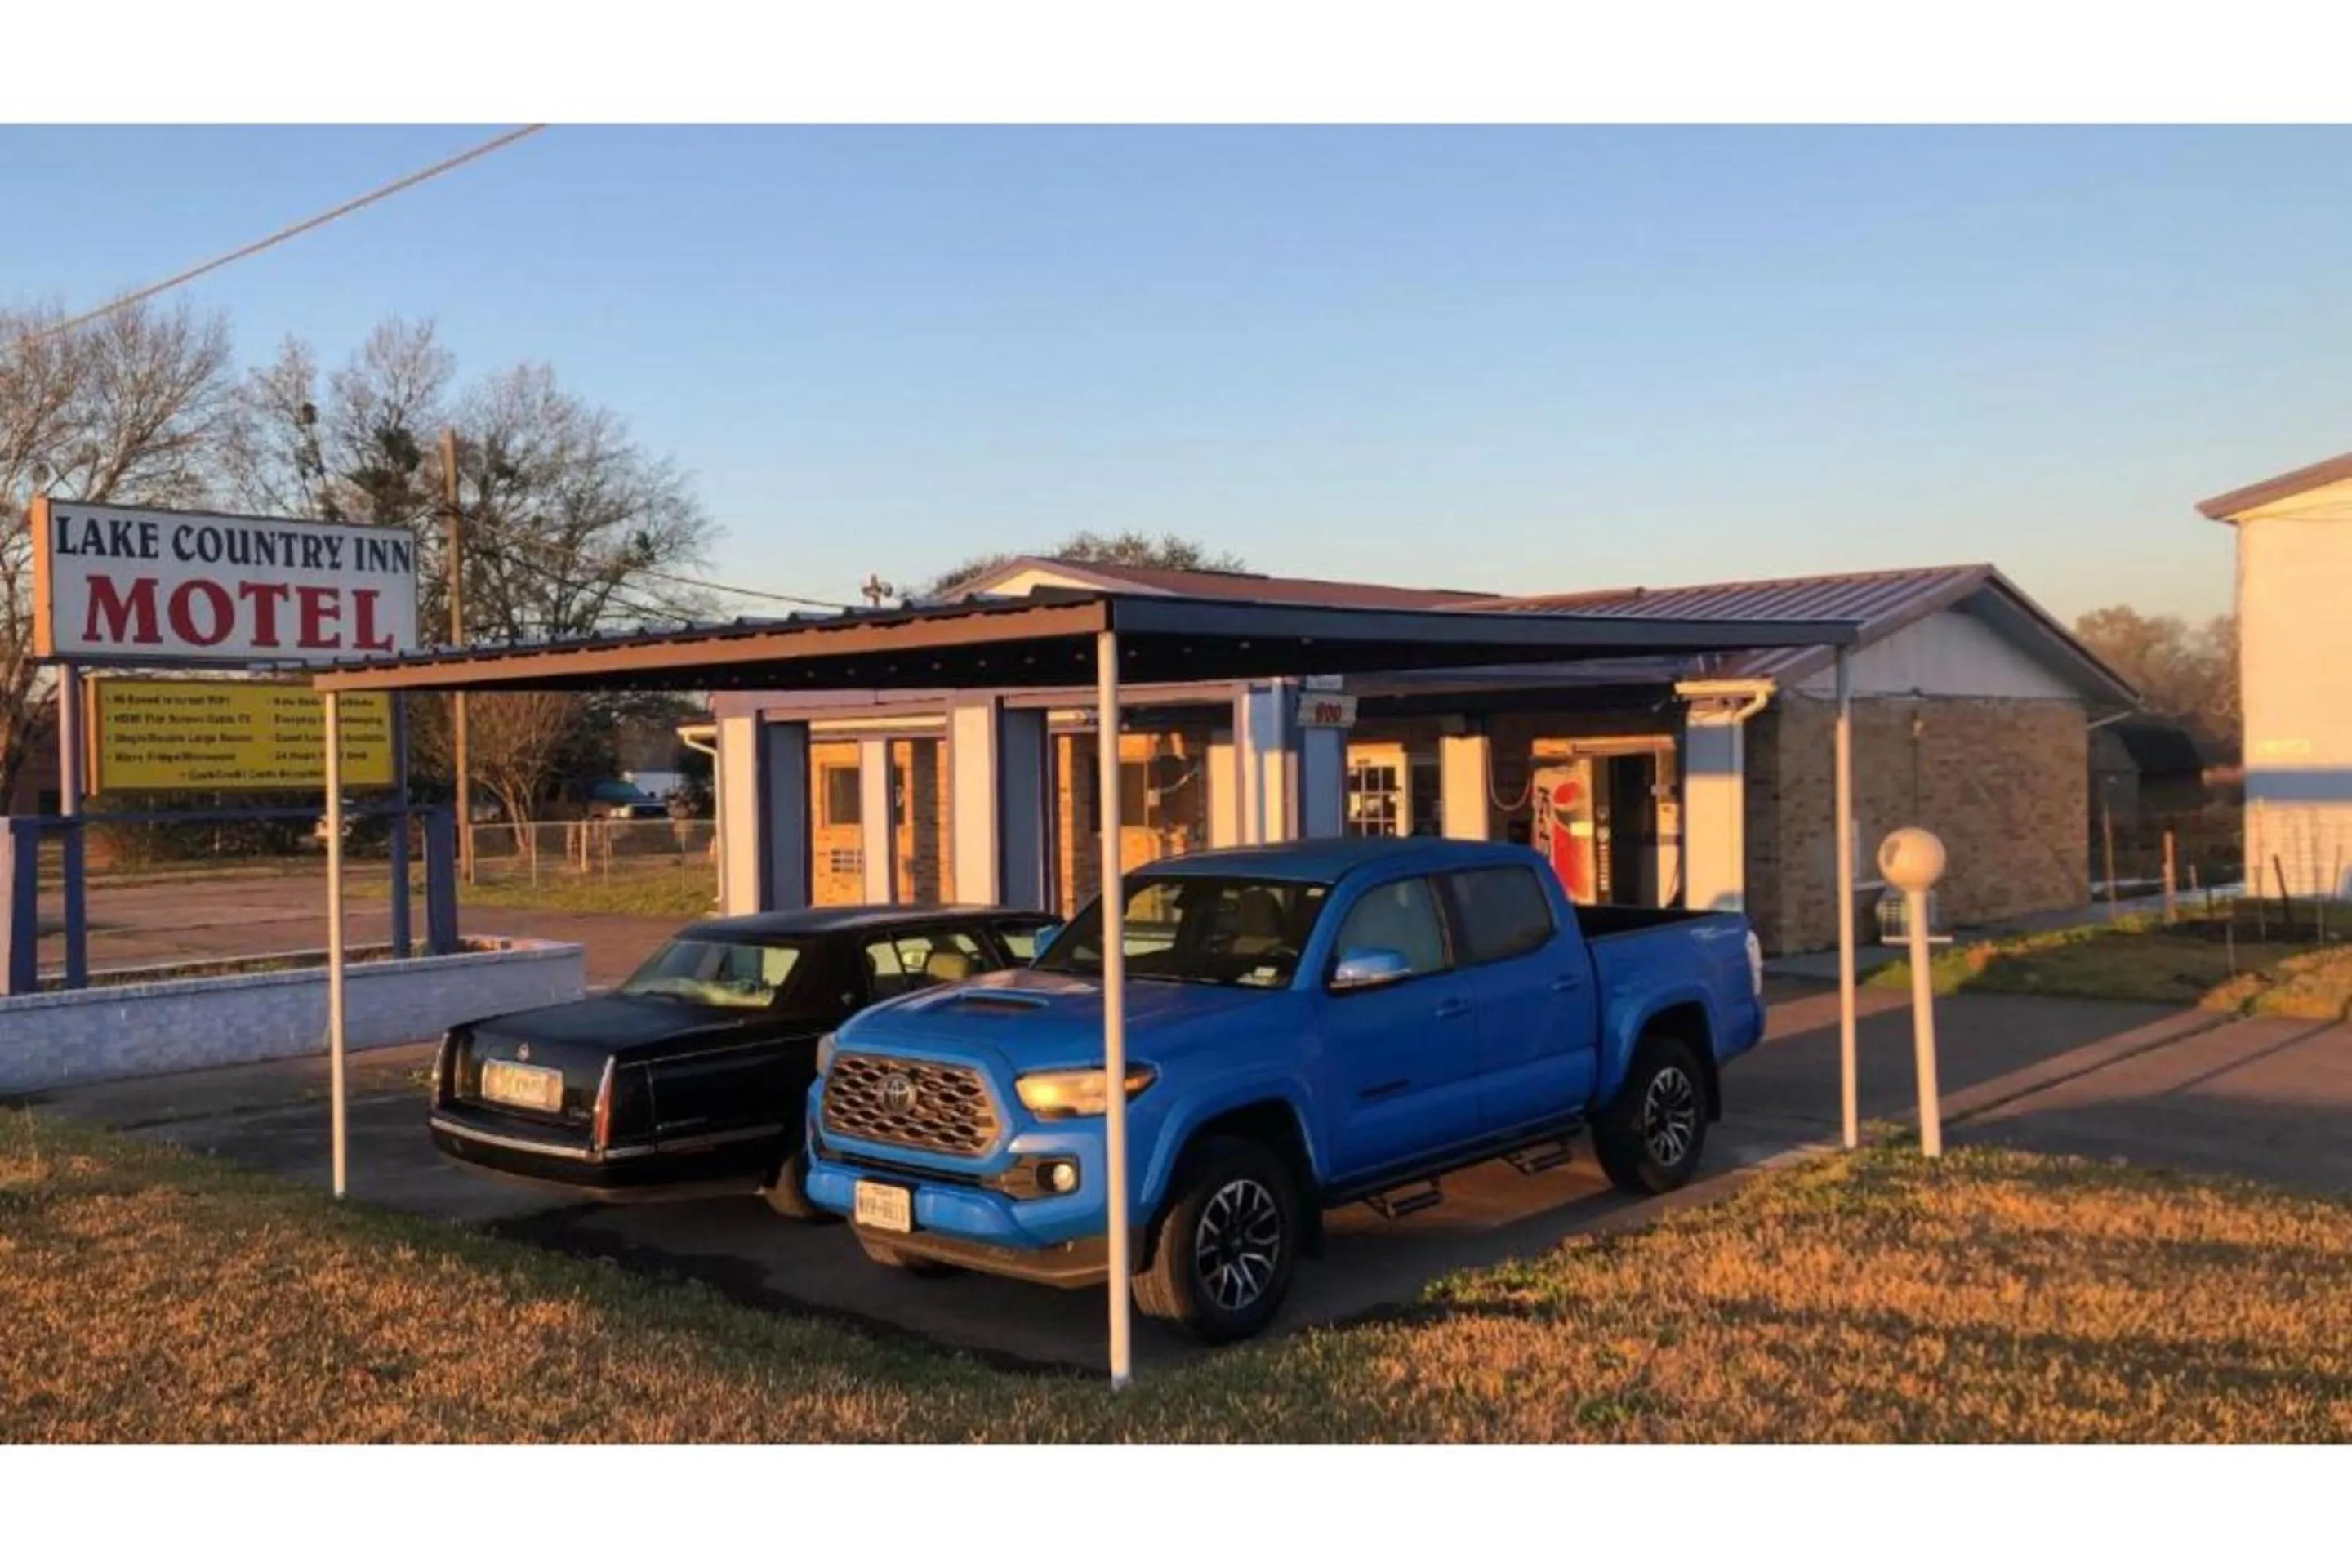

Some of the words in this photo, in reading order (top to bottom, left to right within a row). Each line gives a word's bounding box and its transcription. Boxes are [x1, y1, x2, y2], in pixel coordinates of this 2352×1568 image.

[56, 515, 159, 559] LAKE
[172, 523, 344, 570] COUNTRY
[354, 537, 411, 574] INN
[82, 574, 394, 653] MOTEL
